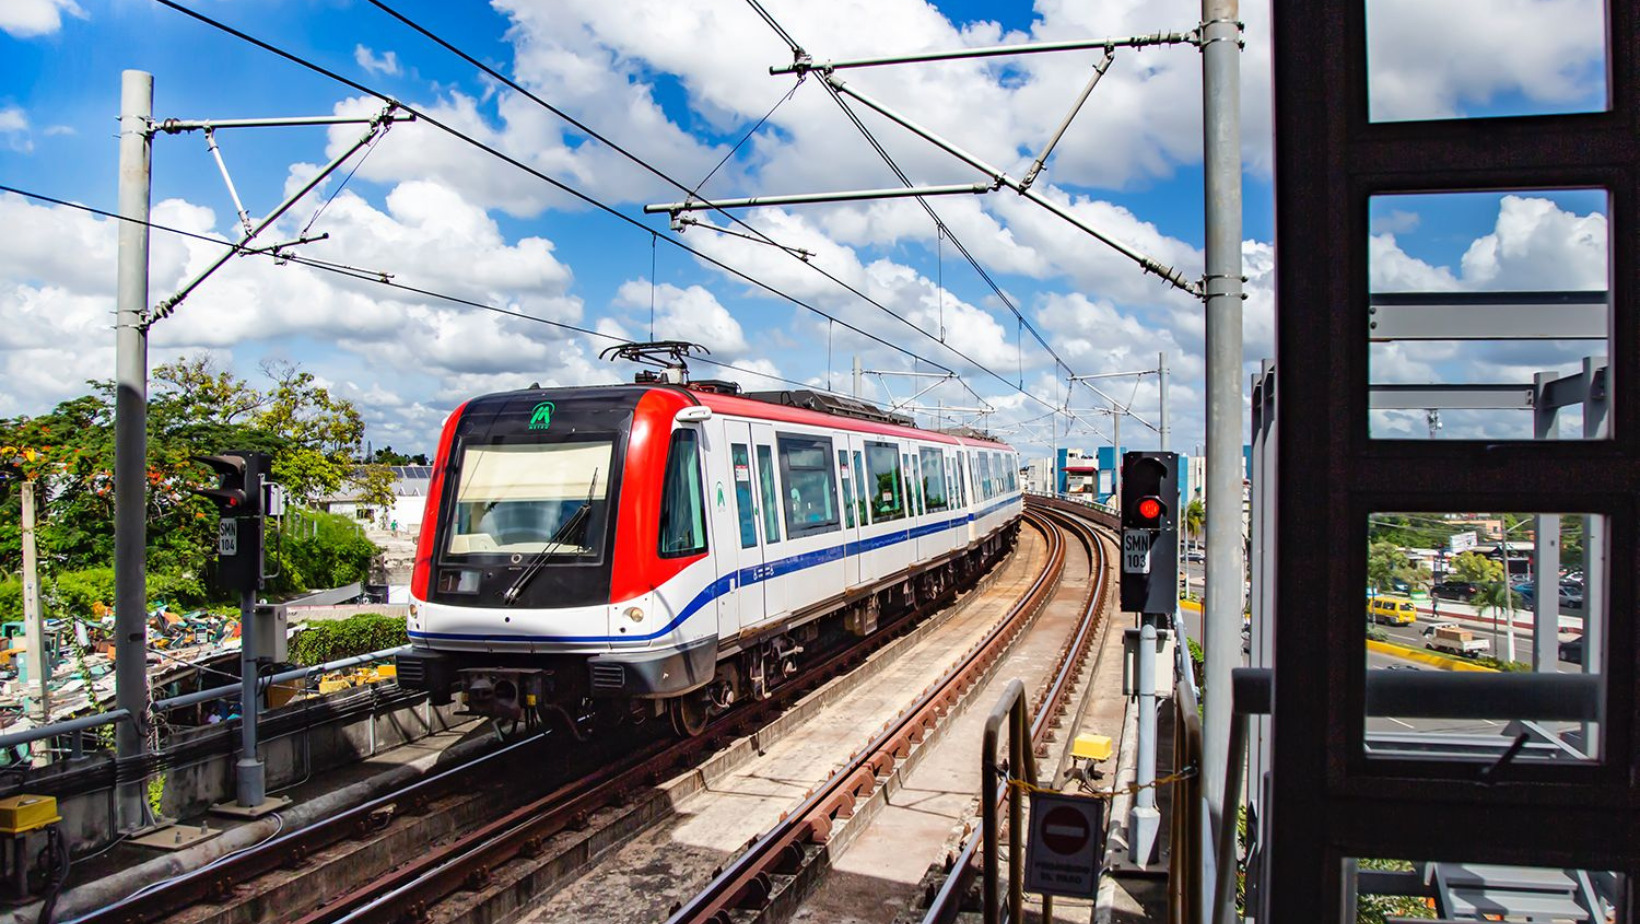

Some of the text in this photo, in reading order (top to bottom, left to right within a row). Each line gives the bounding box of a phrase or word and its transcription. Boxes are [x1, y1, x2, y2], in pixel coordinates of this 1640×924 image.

[220, 522, 236, 537] SMN
[221, 538, 235, 551] 104
[1125, 535, 1148, 551] SMN
[1127, 554, 1147, 568] 103
